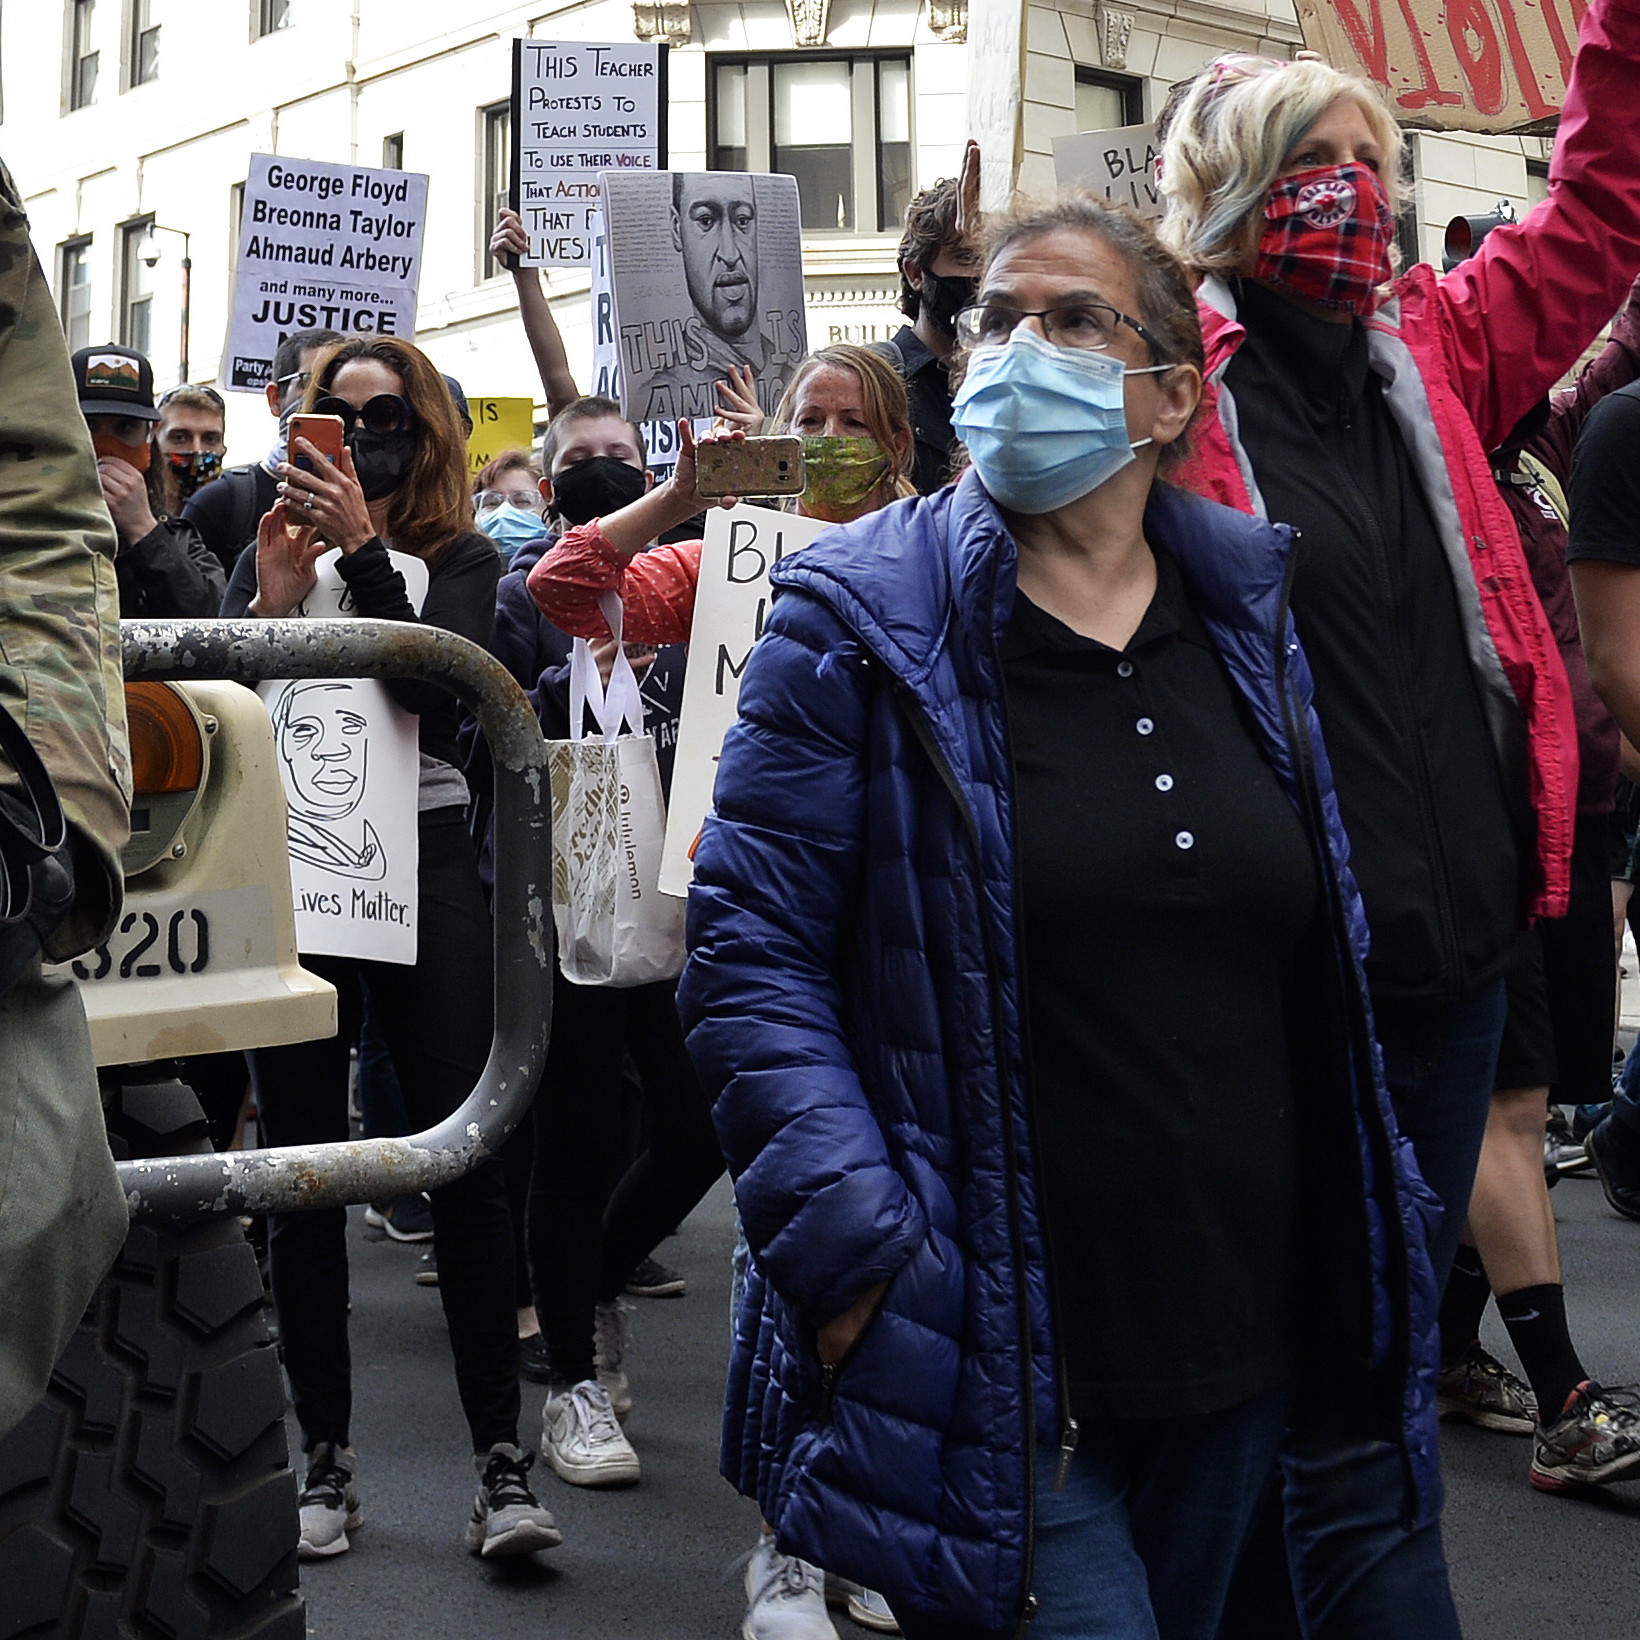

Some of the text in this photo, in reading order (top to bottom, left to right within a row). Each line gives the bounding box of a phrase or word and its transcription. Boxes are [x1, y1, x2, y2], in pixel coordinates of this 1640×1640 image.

[526, 45, 654, 79] THIS TEACHER
[529, 86, 636, 113] PROTESTS TO
[531, 122, 647, 139] TEACH STUDENTS
[524, 151, 652, 168] TO USE THEIR VOICE
[1103, 143, 1160, 179] BLA
[268, 164, 408, 207] George Floyd
[522, 180, 553, 199] THAT
[252, 199, 416, 241] Breonna Taylor
[526, 207, 575, 231] THAT
[246, 235, 413, 279] Ahmaud Arbery
[527, 238, 584, 260] LIVES
[260, 280, 394, 305] and many more...
[252, 300, 397, 336] JUSTICE
[621, 316, 709, 374] THIS
[767, 310, 804, 363] IS
[235, 358, 264, 376] Party
[620, 811, 642, 900] lululemon
[351, 887, 411, 928] Matter.
